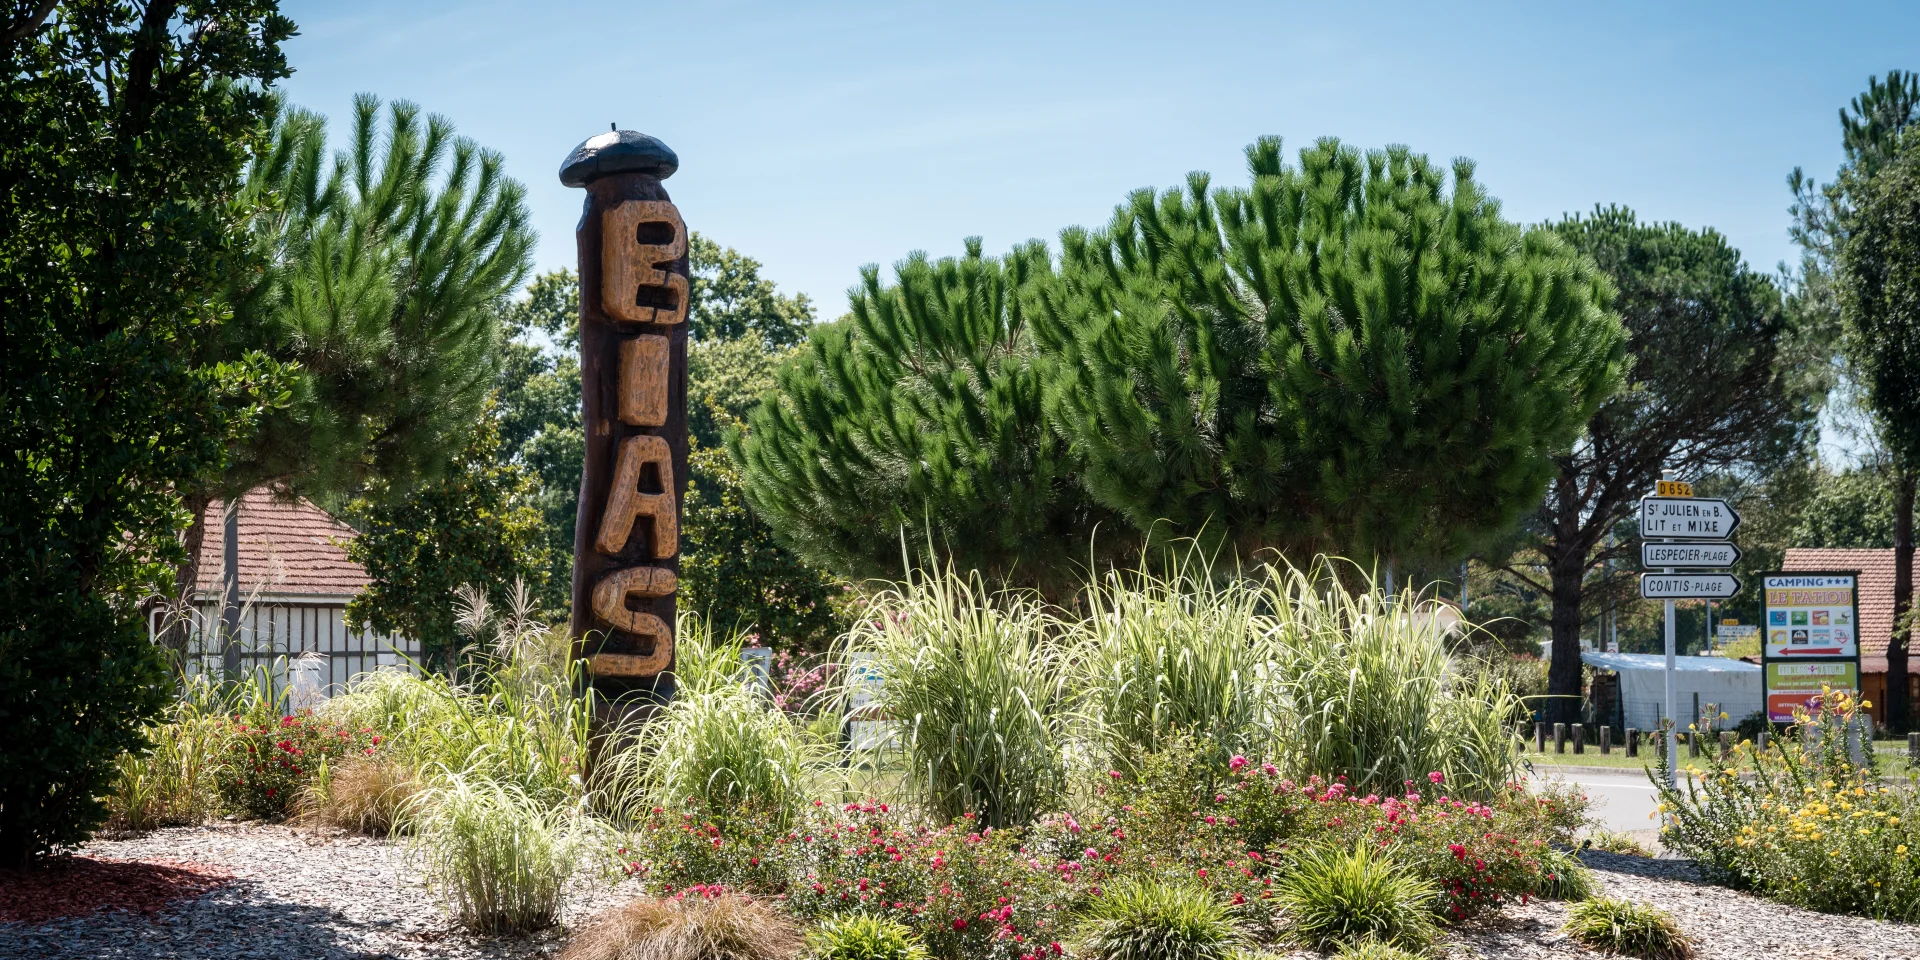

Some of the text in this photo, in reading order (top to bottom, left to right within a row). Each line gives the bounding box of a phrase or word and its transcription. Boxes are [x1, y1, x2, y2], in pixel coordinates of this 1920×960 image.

[590, 200, 689, 677] BIAS
[1660, 484, 1691, 495] D 652
[1662, 504, 1700, 517] JULIEN
[1702, 509, 1711, 517] EN
[1713, 506, 1723, 518] B.
[1647, 519, 1718, 532] LIT ET MIXE
[1768, 578, 1824, 587] CAMPING
[1768, 590, 1851, 605] LE TATIOU
[1779, 665, 1808, 674] FITNESS
[1817, 664, 1844, 674] NATURE
